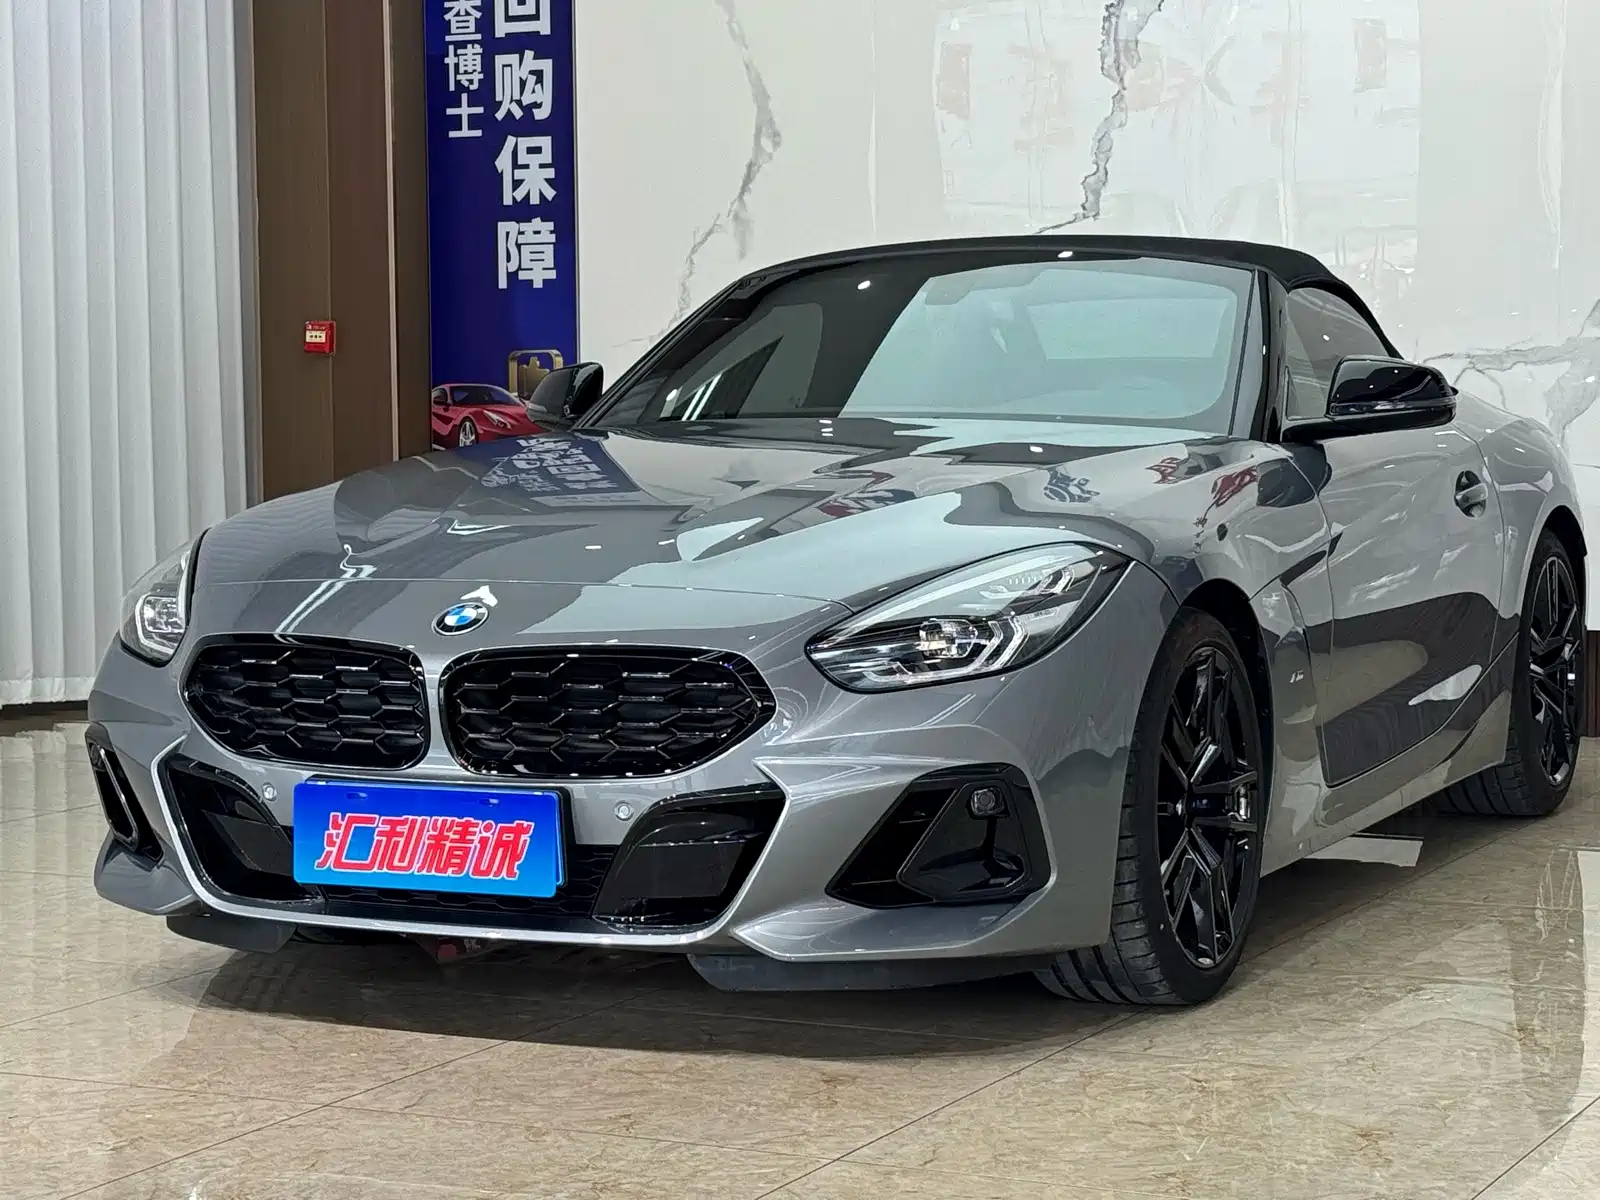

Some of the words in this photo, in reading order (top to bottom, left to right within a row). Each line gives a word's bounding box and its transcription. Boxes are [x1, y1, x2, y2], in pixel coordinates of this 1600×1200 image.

[443, 0, 484, 138] 查博士
[315, 812, 534, 880] 汇利精诚
